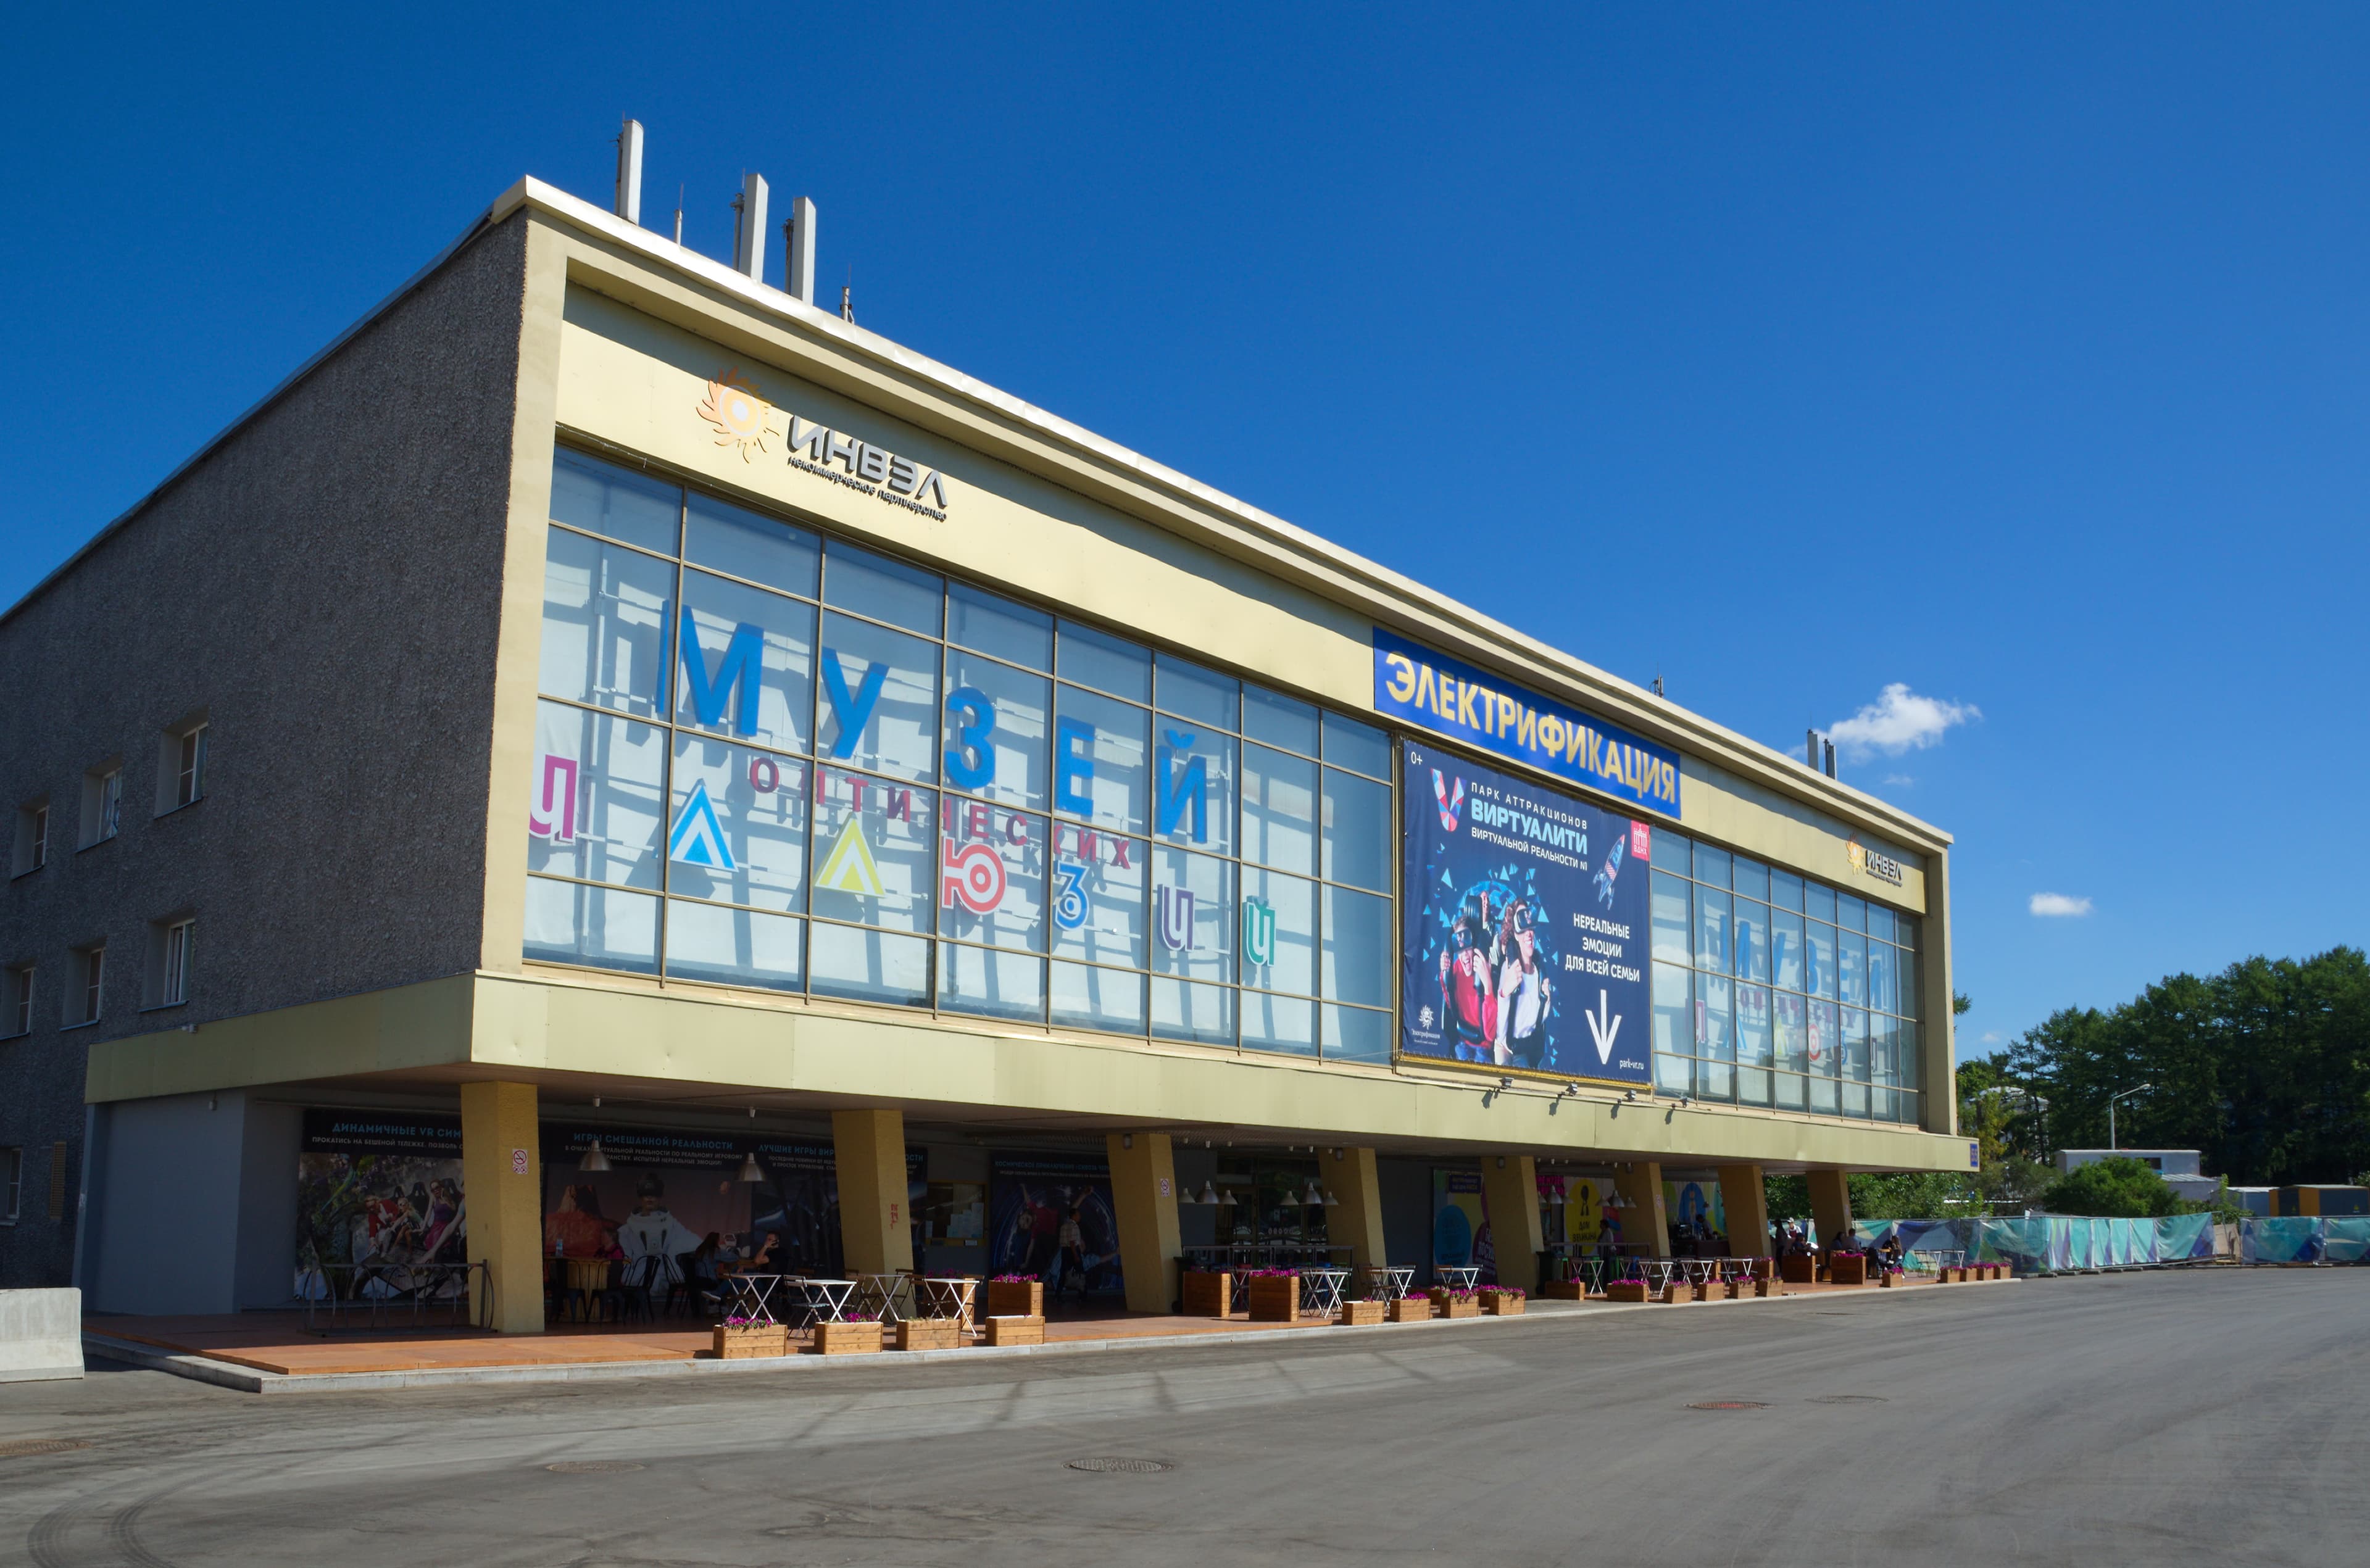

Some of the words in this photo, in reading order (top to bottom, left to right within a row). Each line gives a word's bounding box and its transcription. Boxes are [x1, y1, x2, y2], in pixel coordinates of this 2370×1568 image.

[787, 415, 948, 508] ИНВЭЛ
[788, 456, 876, 496] некоммерческое
[878, 489, 947, 522] партнерство
[657, 599, 1207, 844] МУЗЕЙ
[1386, 651, 1675, 804] ЭЛЕКТРИФИКАЦИЯ
[1411, 752, 1423, 765] 0+
[1471, 782, 1500, 800] ПАРК
[1506, 794, 1587, 830] АТТРАКЦИОНОВ
[1471, 798, 1587, 855] ВИРТУАЛИТИ
[1471, 827, 1529, 853] ВИРТУАЛЬНОЙ
[1531, 845, 1578, 868] РЕАЛЬНОСТИ
[1866, 850, 1903, 881] ИНВЭЛ
[1574, 913, 1630, 939] НЕРЕАЛЬНЫЕ
[1582, 937, 1622, 958] ЭМОЦИИ
[1565, 955, 1584, 971] ДЛЯ
[1587, 960, 1609, 976] ВСЕЙ
[1611, 964, 1640, 982] СЕМЬИ
[1620, 1058, 1644, 1069] park-vr.ru
[312, 1136, 352, 1145] ПРОКАТИСЬ
[331, 1122, 416, 1136] ДИНАМИЧНЫЕ
[420, 1127, 435, 1137] VR
[573, 1132, 602, 1143] ИГРЫ
[606, 1135, 670, 1147] СМЕШАННОЙ
[672, 1139, 733, 1150] РЕАЛЬНОСТИ
[601, 1147, 633, 1155] РТУАЛЬНОЙ
[759, 1144, 792, 1153] ЛУЧШИЕ
[794, 1146, 817, 1155] ИГРЫ
